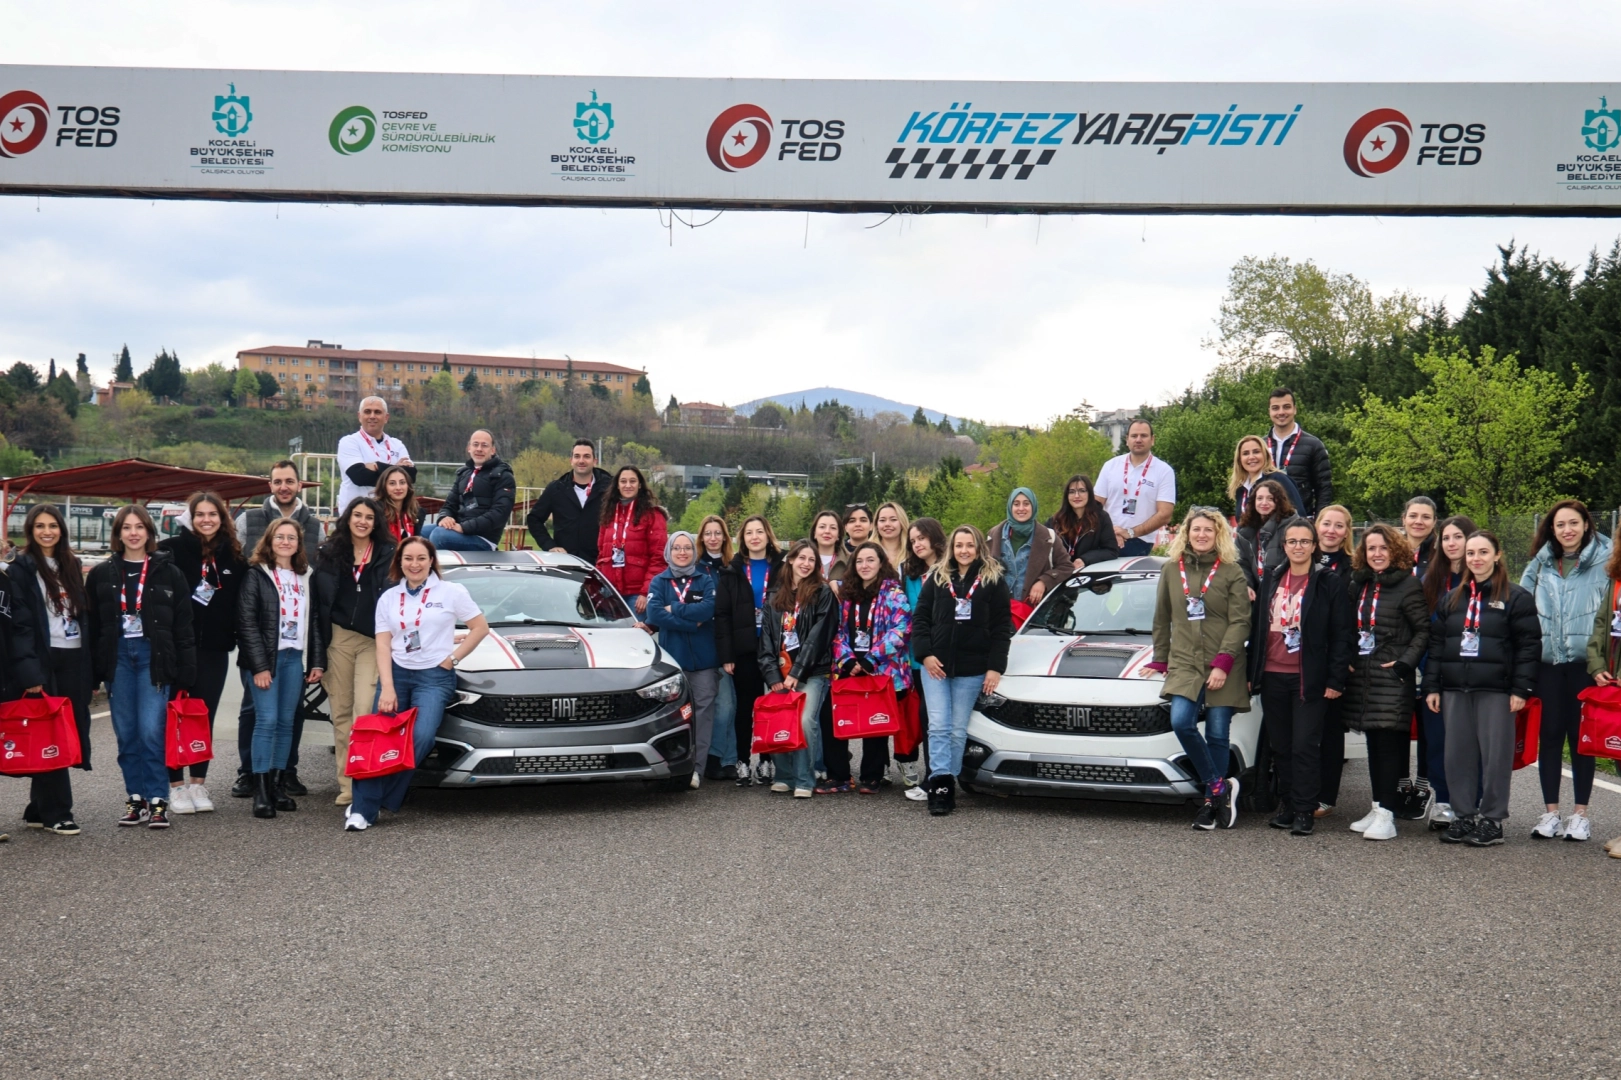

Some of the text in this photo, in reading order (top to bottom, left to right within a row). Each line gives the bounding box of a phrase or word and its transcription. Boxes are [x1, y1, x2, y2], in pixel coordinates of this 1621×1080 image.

[56, 105, 120, 126] TOS
[382, 110, 428, 120] TOSFED
[56, 127, 118, 148] FED
[381, 122, 437, 132] ÇEVRE VE
[381, 131, 496, 144] SÜRDÜRÜLEBİLİRLİK
[780, 119, 845, 140] TOS
[1420, 123, 1486, 144] TOS
[381, 142, 452, 154] KOMİSYONU
[777, 141, 842, 162] FED
[1416, 145, 1482, 166] FED
[552, 697, 578, 718] FIAT
[1066, 707, 1092, 727] FIAT
